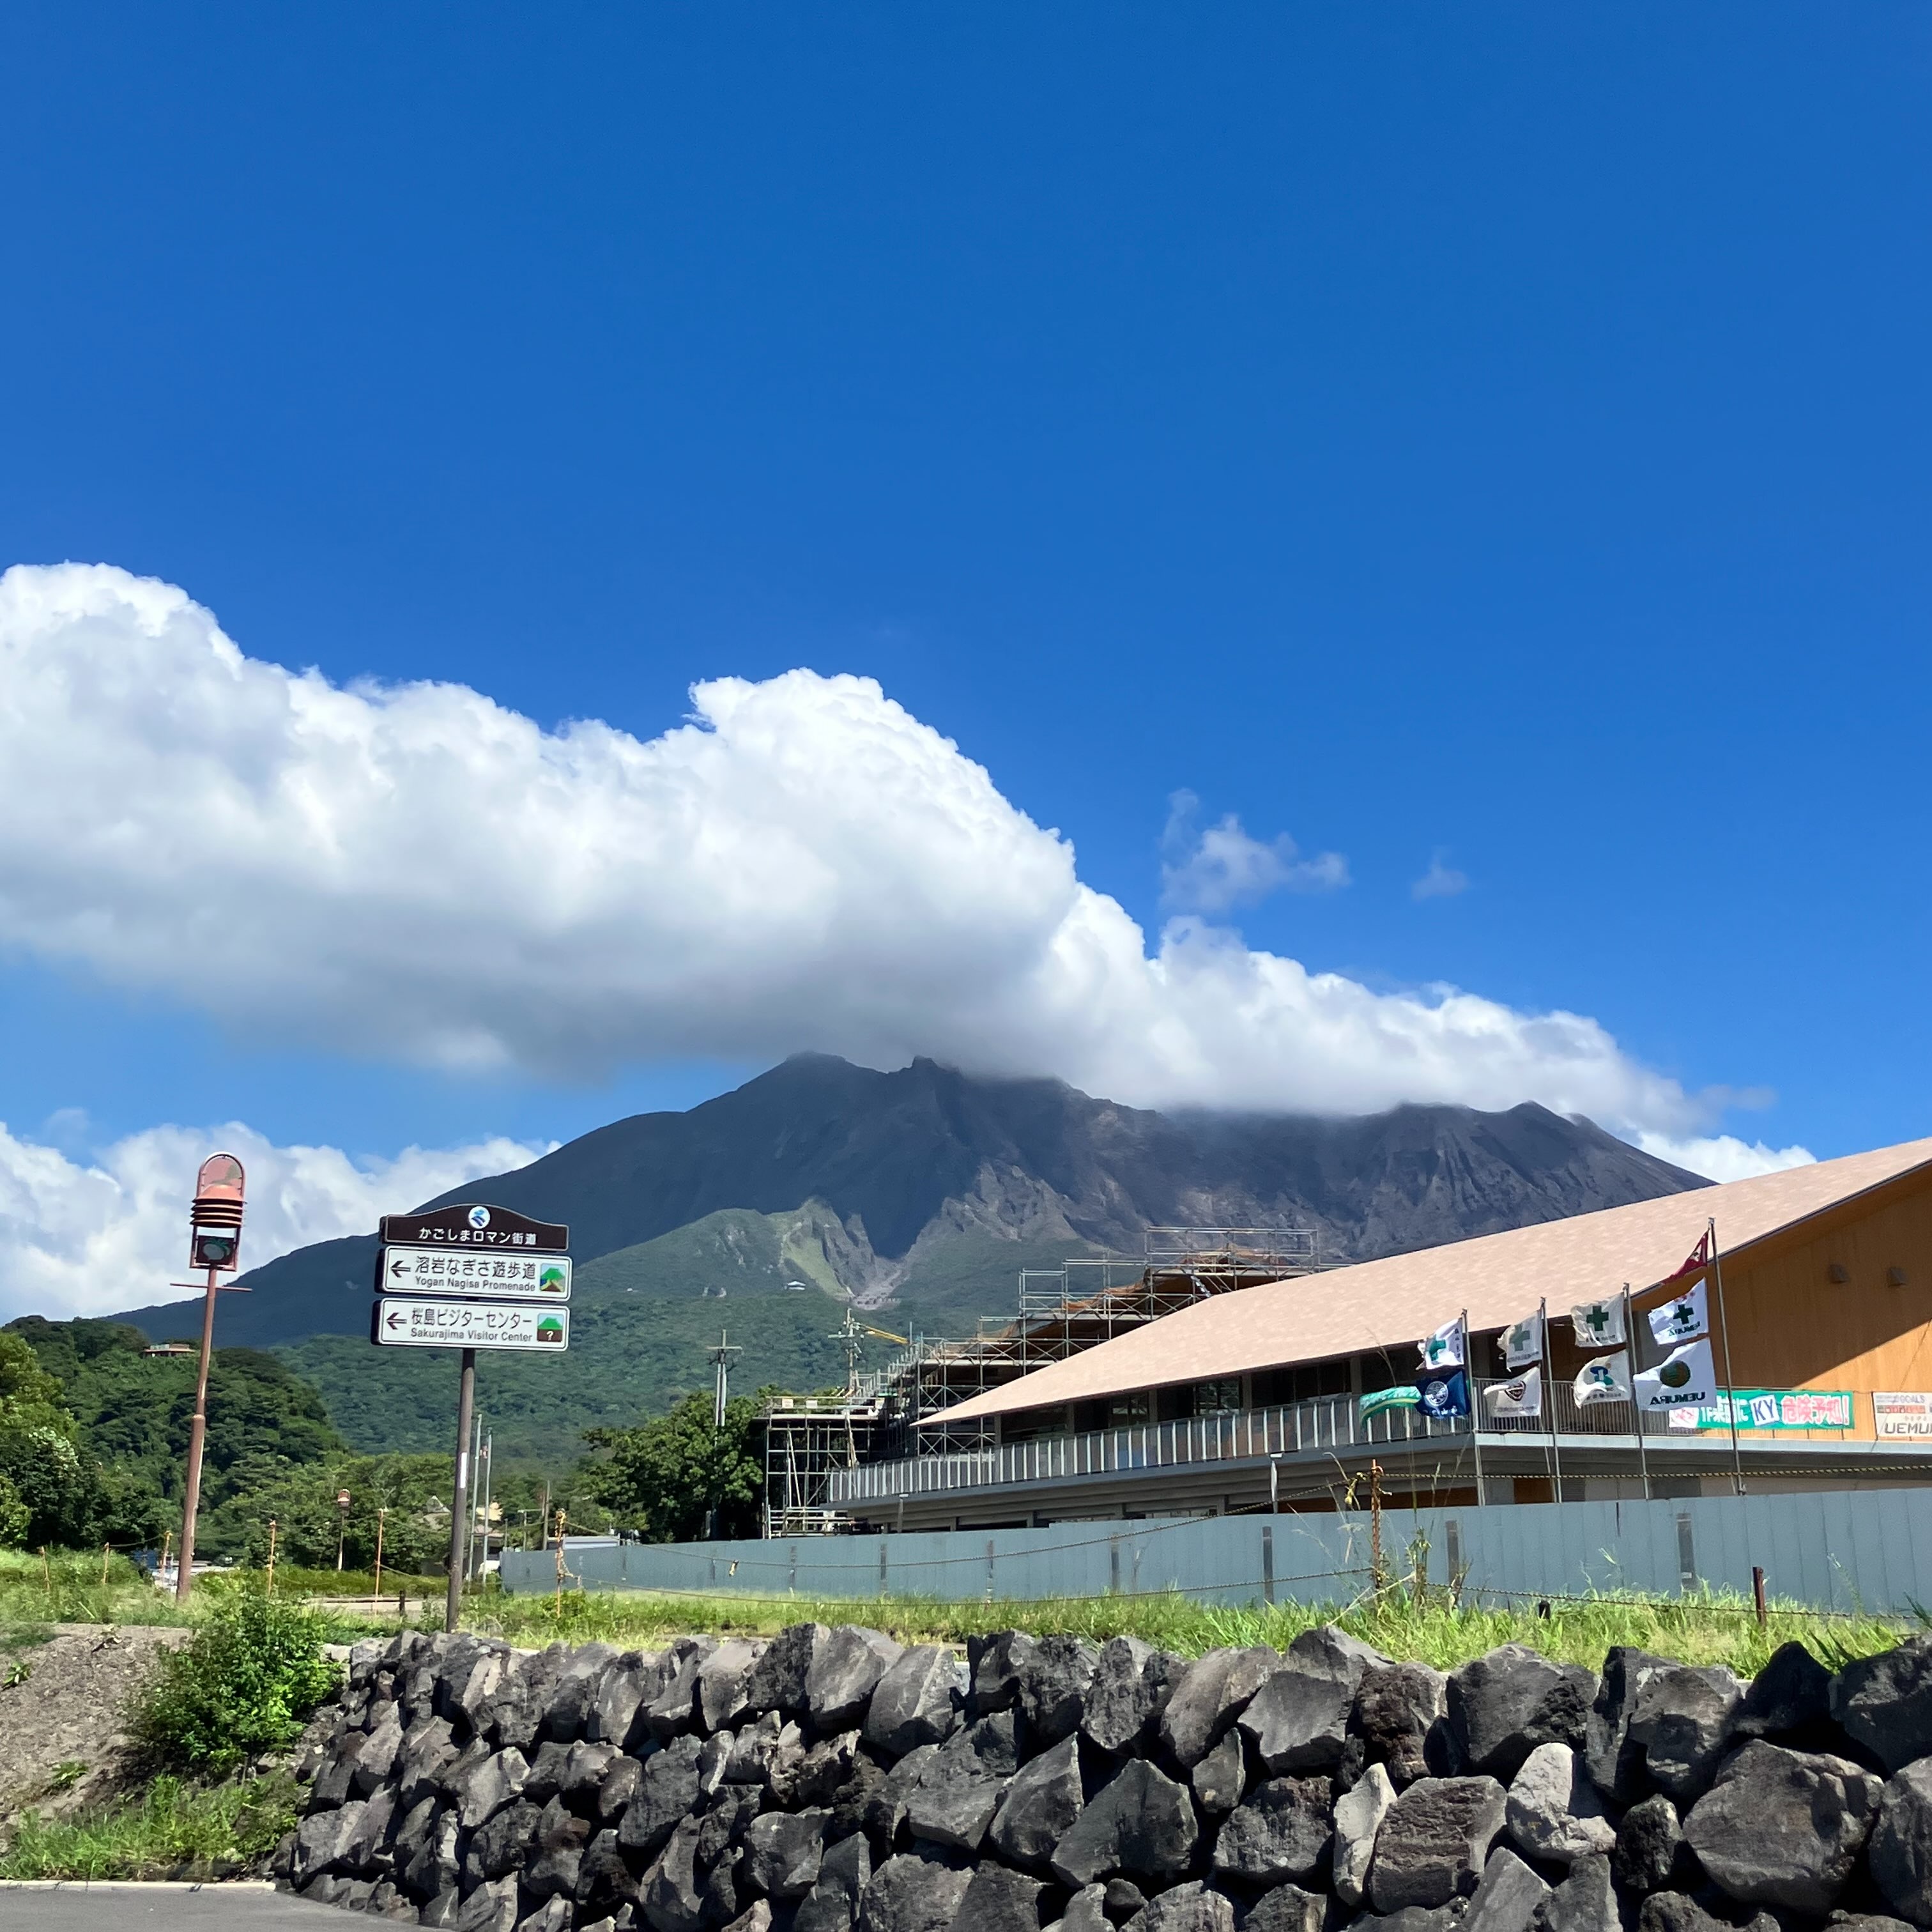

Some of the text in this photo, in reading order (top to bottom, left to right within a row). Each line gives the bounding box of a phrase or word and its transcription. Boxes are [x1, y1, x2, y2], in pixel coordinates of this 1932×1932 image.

[419, 1227, 537, 1245] かごしまロマン街道
[416, 1255, 536, 1279] 溶岩なぎさ遊歩道
[415, 1276, 535, 1291] Yogan Nagisa Promenade
[412, 1307, 532, 1329] 桜島ビジターセンター
[411, 1328, 532, 1342] Sakurajima Visitor Center
[1753, 1399, 1774, 1422] KY
[1884, 1422, 1932, 1434] UEMU
